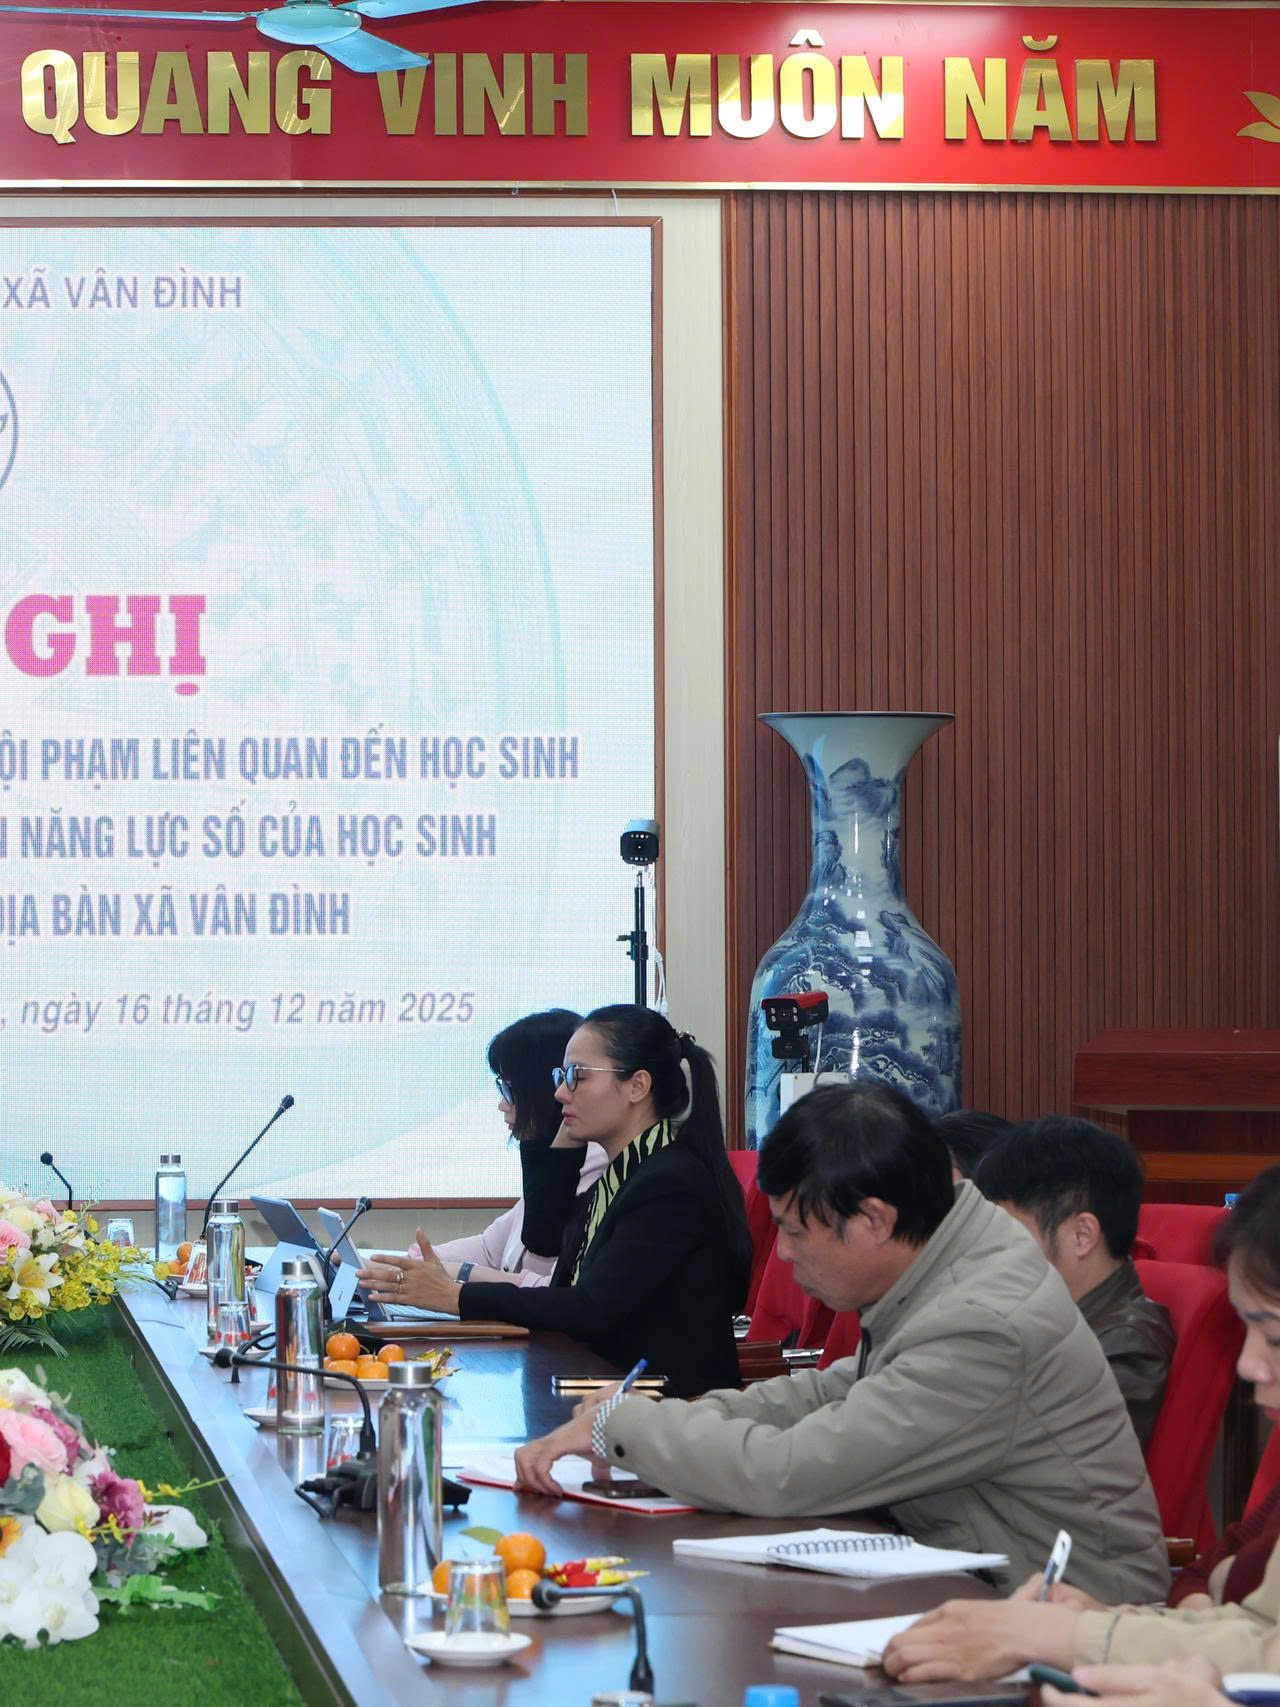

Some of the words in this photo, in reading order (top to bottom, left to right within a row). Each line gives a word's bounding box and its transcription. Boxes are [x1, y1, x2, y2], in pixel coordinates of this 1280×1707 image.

[20, 49, 332, 145] QUANG
[376, 52, 587, 136] VINH
[631, 29, 905, 139] MUÔN
[945, 35, 1157, 142] NĂM
[2, 266, 52, 309] XÃ
[64, 267, 139, 309] VÂN
[153, 266, 243, 309] ĐÌNH
[41, 736, 140, 790] PHẠM
[152, 729, 225, 781] LIÊN
[238, 736, 328, 784] QUAN
[340, 722, 407, 780] ĐẾN
[420, 736, 486, 789] HỌC
[498, 736, 579, 780] SINH
[20, 807, 115, 859] NĂNG
[127, 812, 189, 868] LỰC
[202, 798, 248, 859] SỐ
[258, 800, 325, 858] CỦA
[337, 813, 404, 866] HỌC
[416, 813, 497, 857] SINH
[52, 885, 122, 937] BÀN
[134, 884, 178, 936] XÃ
[191, 884, 257, 936] VÂN
[269, 883, 350, 936] ĐÌNH
[21, 995, 102, 1033] ngày
[116, 994, 150, 1025] 16
[161, 991, 257, 1033] tháng
[271, 993, 306, 1024] 12
[317, 994, 386, 1024] năm
[398, 992, 476, 1024] 2025
